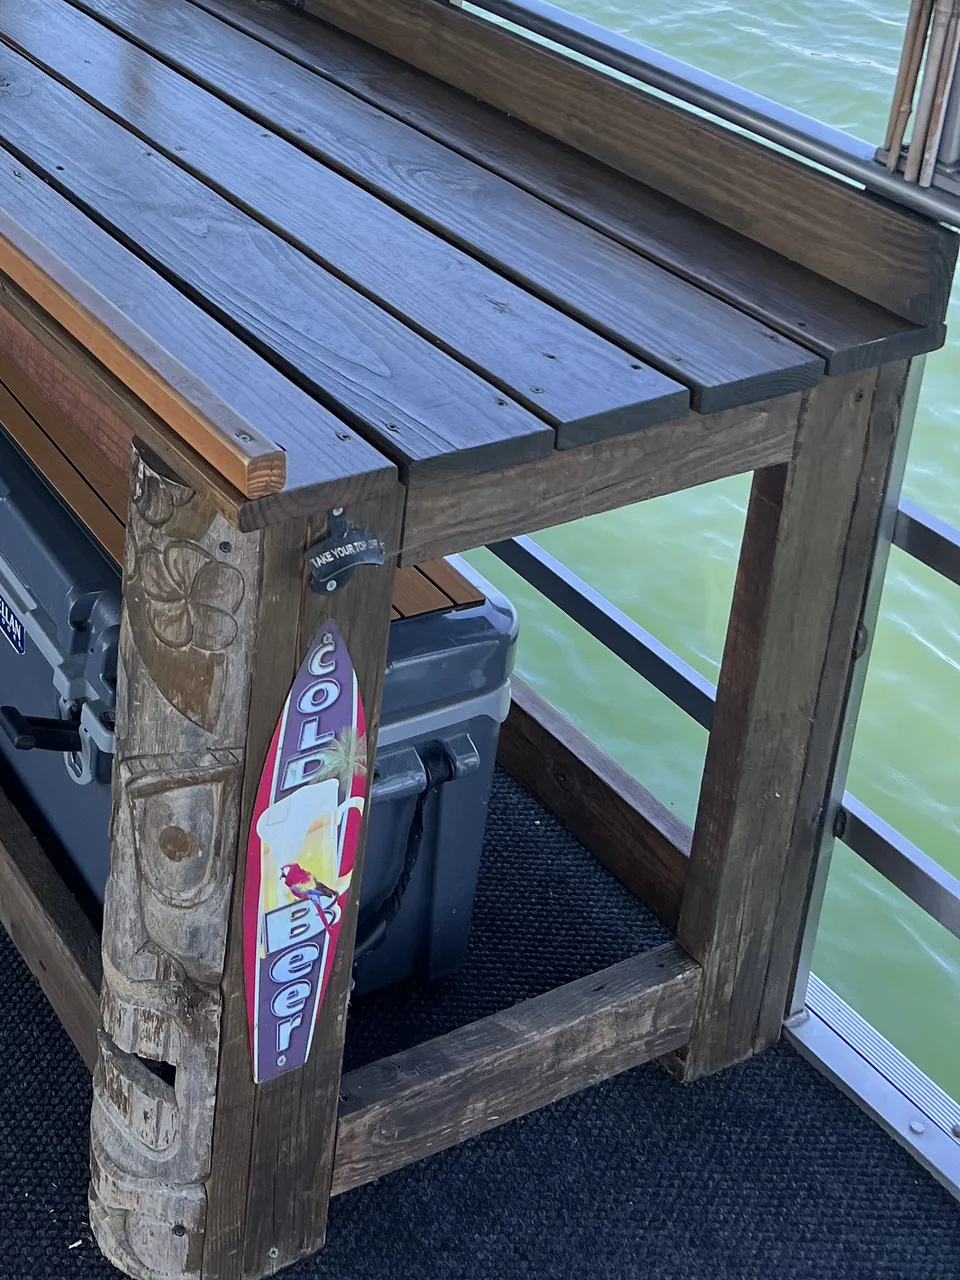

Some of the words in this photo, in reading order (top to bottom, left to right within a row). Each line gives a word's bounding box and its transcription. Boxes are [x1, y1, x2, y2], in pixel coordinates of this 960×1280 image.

[310, 552, 334, 569] TAKE
[331, 543, 356, 559] YOUR
[352, 540, 368, 554] TOP
[280, 641, 342, 792] COLD
[265, 897, 341, 1054] Beer
